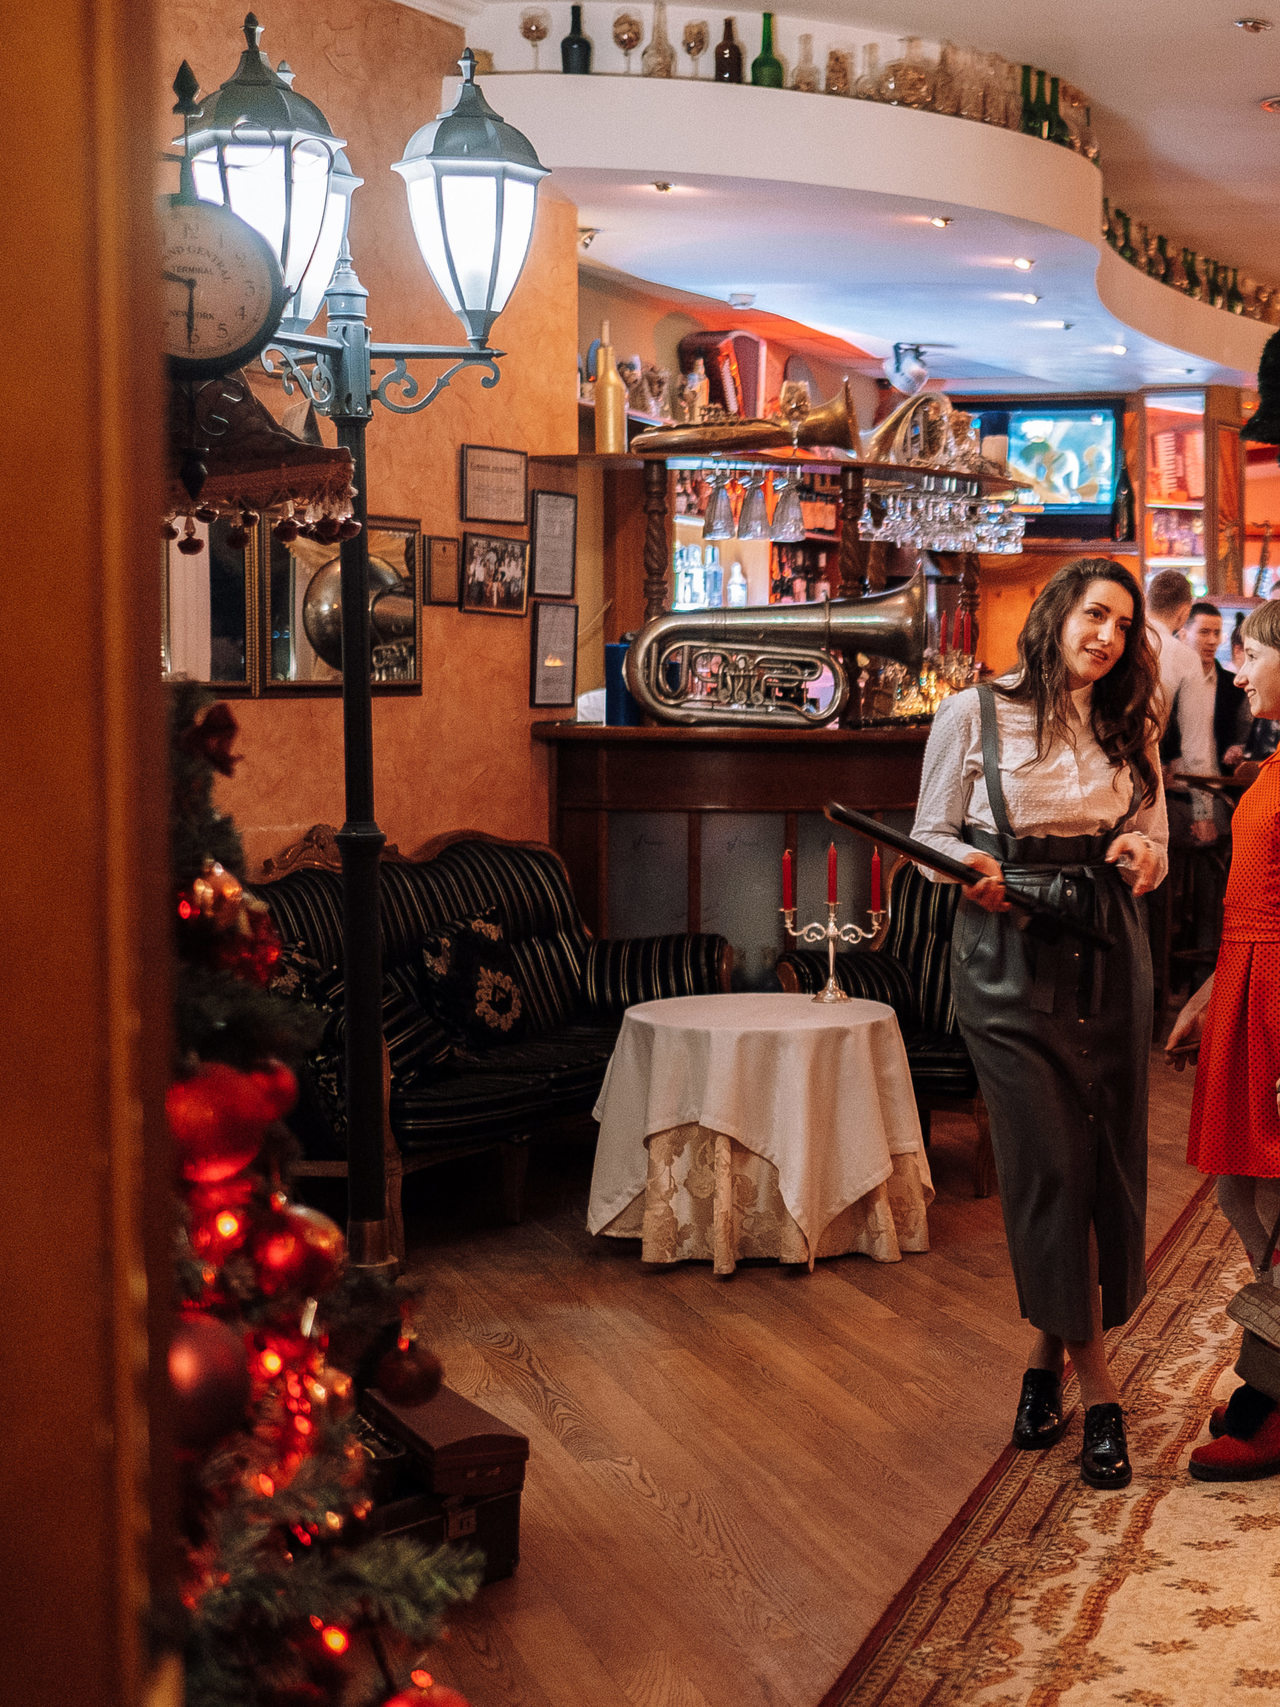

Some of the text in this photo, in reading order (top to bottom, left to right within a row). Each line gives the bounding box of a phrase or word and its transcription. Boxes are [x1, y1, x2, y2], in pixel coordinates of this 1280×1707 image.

[172, 265, 214, 275] TERMINAL
[235, 305, 248, 321] 4
[216, 322, 229, 339] 5
